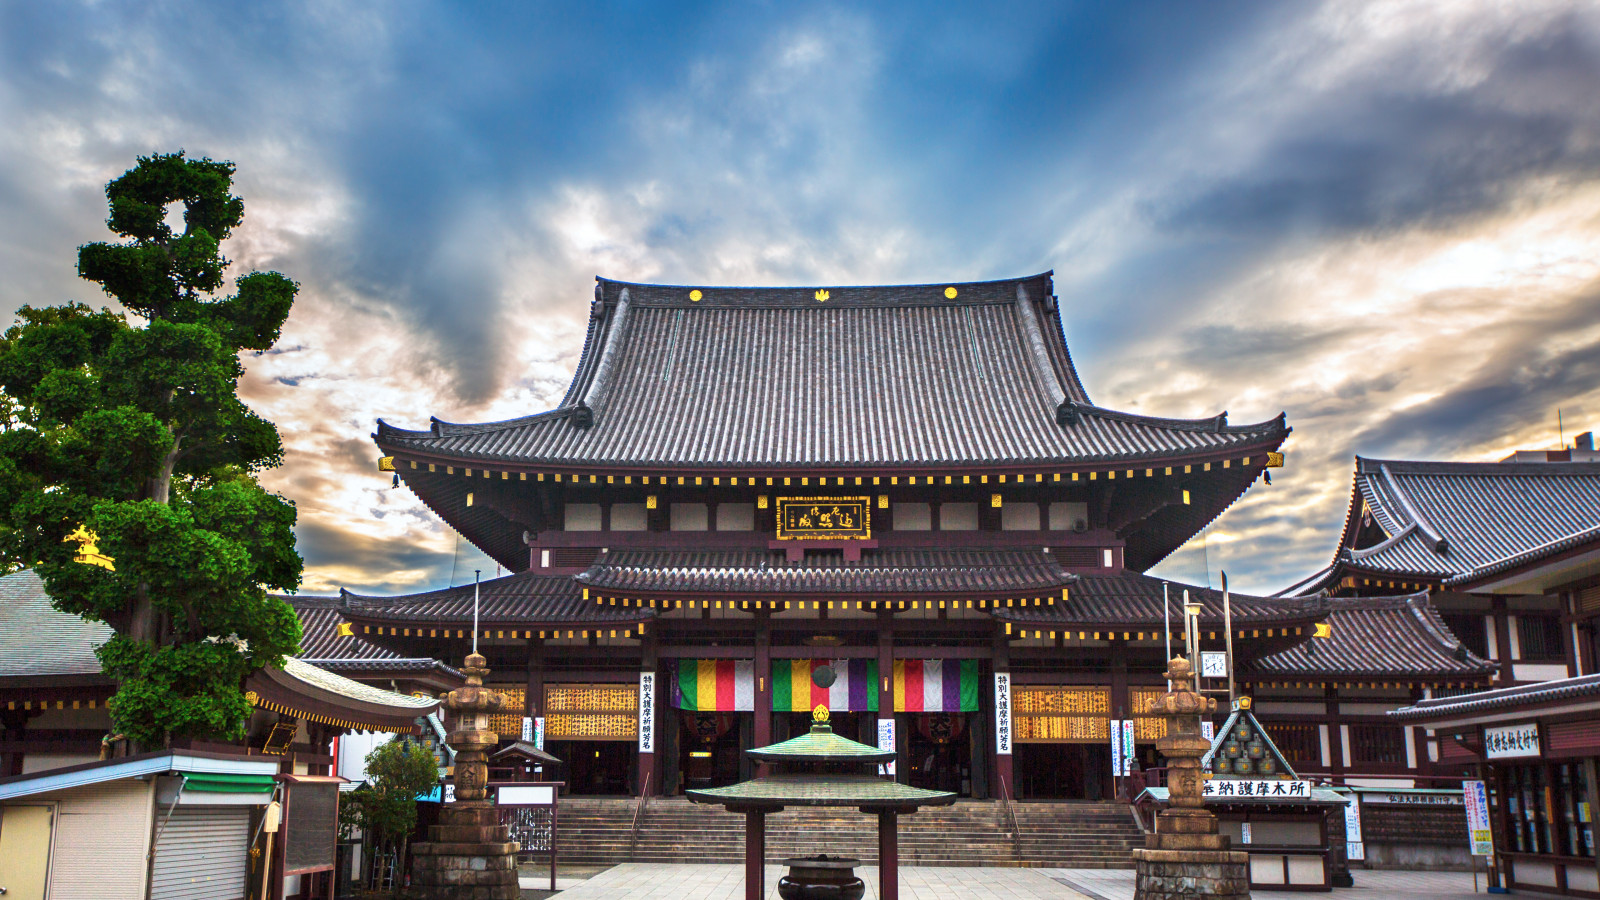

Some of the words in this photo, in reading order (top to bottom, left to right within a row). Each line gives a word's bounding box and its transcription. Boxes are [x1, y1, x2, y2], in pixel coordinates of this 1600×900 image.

[642, 675, 652, 750] 特別大護摩祈願芳名
[997, 675, 1009, 751] 特別大護摩祈願芳名
